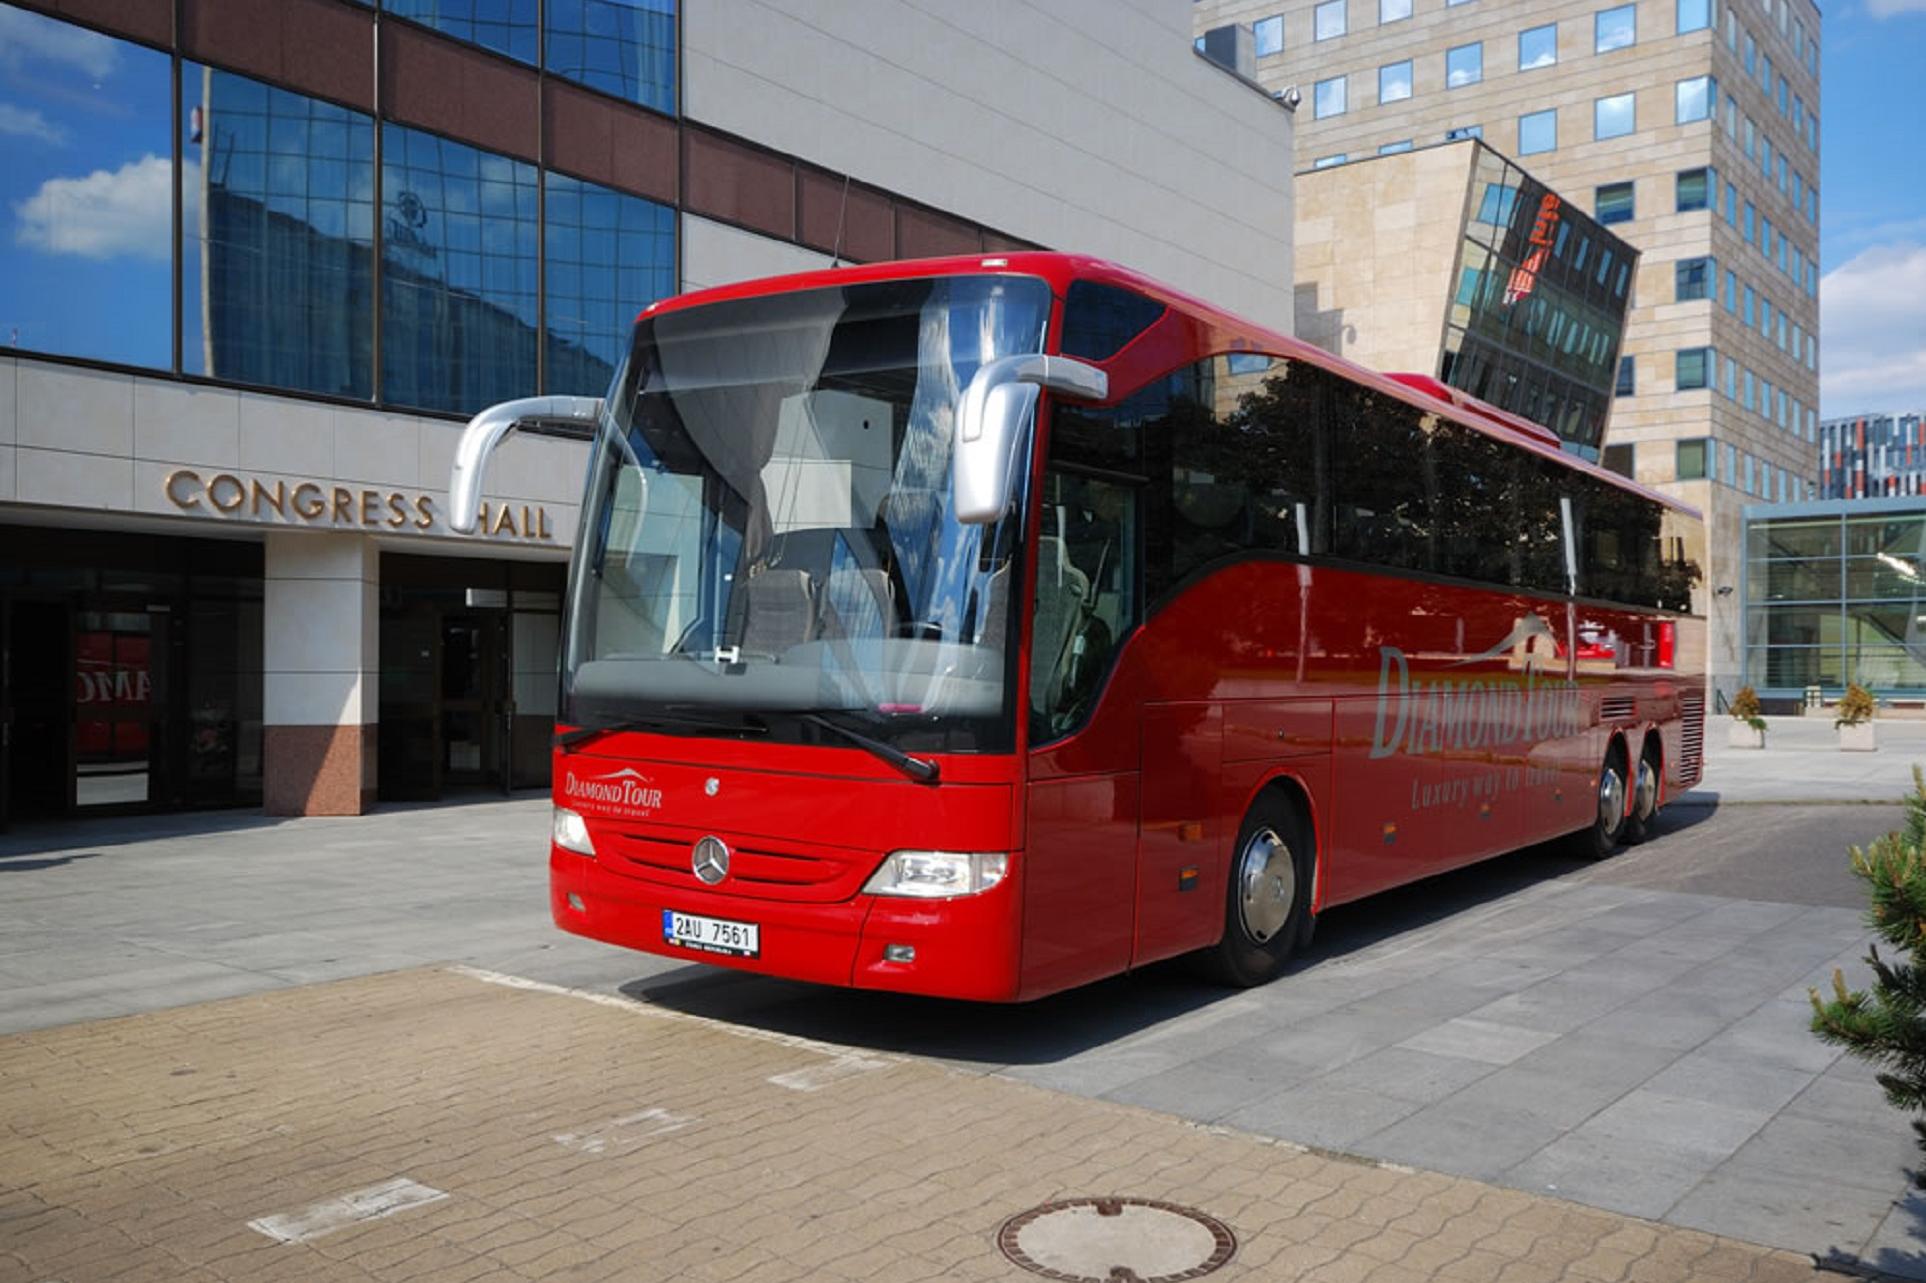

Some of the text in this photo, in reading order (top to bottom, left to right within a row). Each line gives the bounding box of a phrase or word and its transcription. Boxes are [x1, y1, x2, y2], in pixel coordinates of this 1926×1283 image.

[166, 470, 434, 529] CONGRESS
[1411, 777, 1469, 811] Luxury
[676, 917, 702, 938] 2AU
[712, 923, 749, 947] 7561
